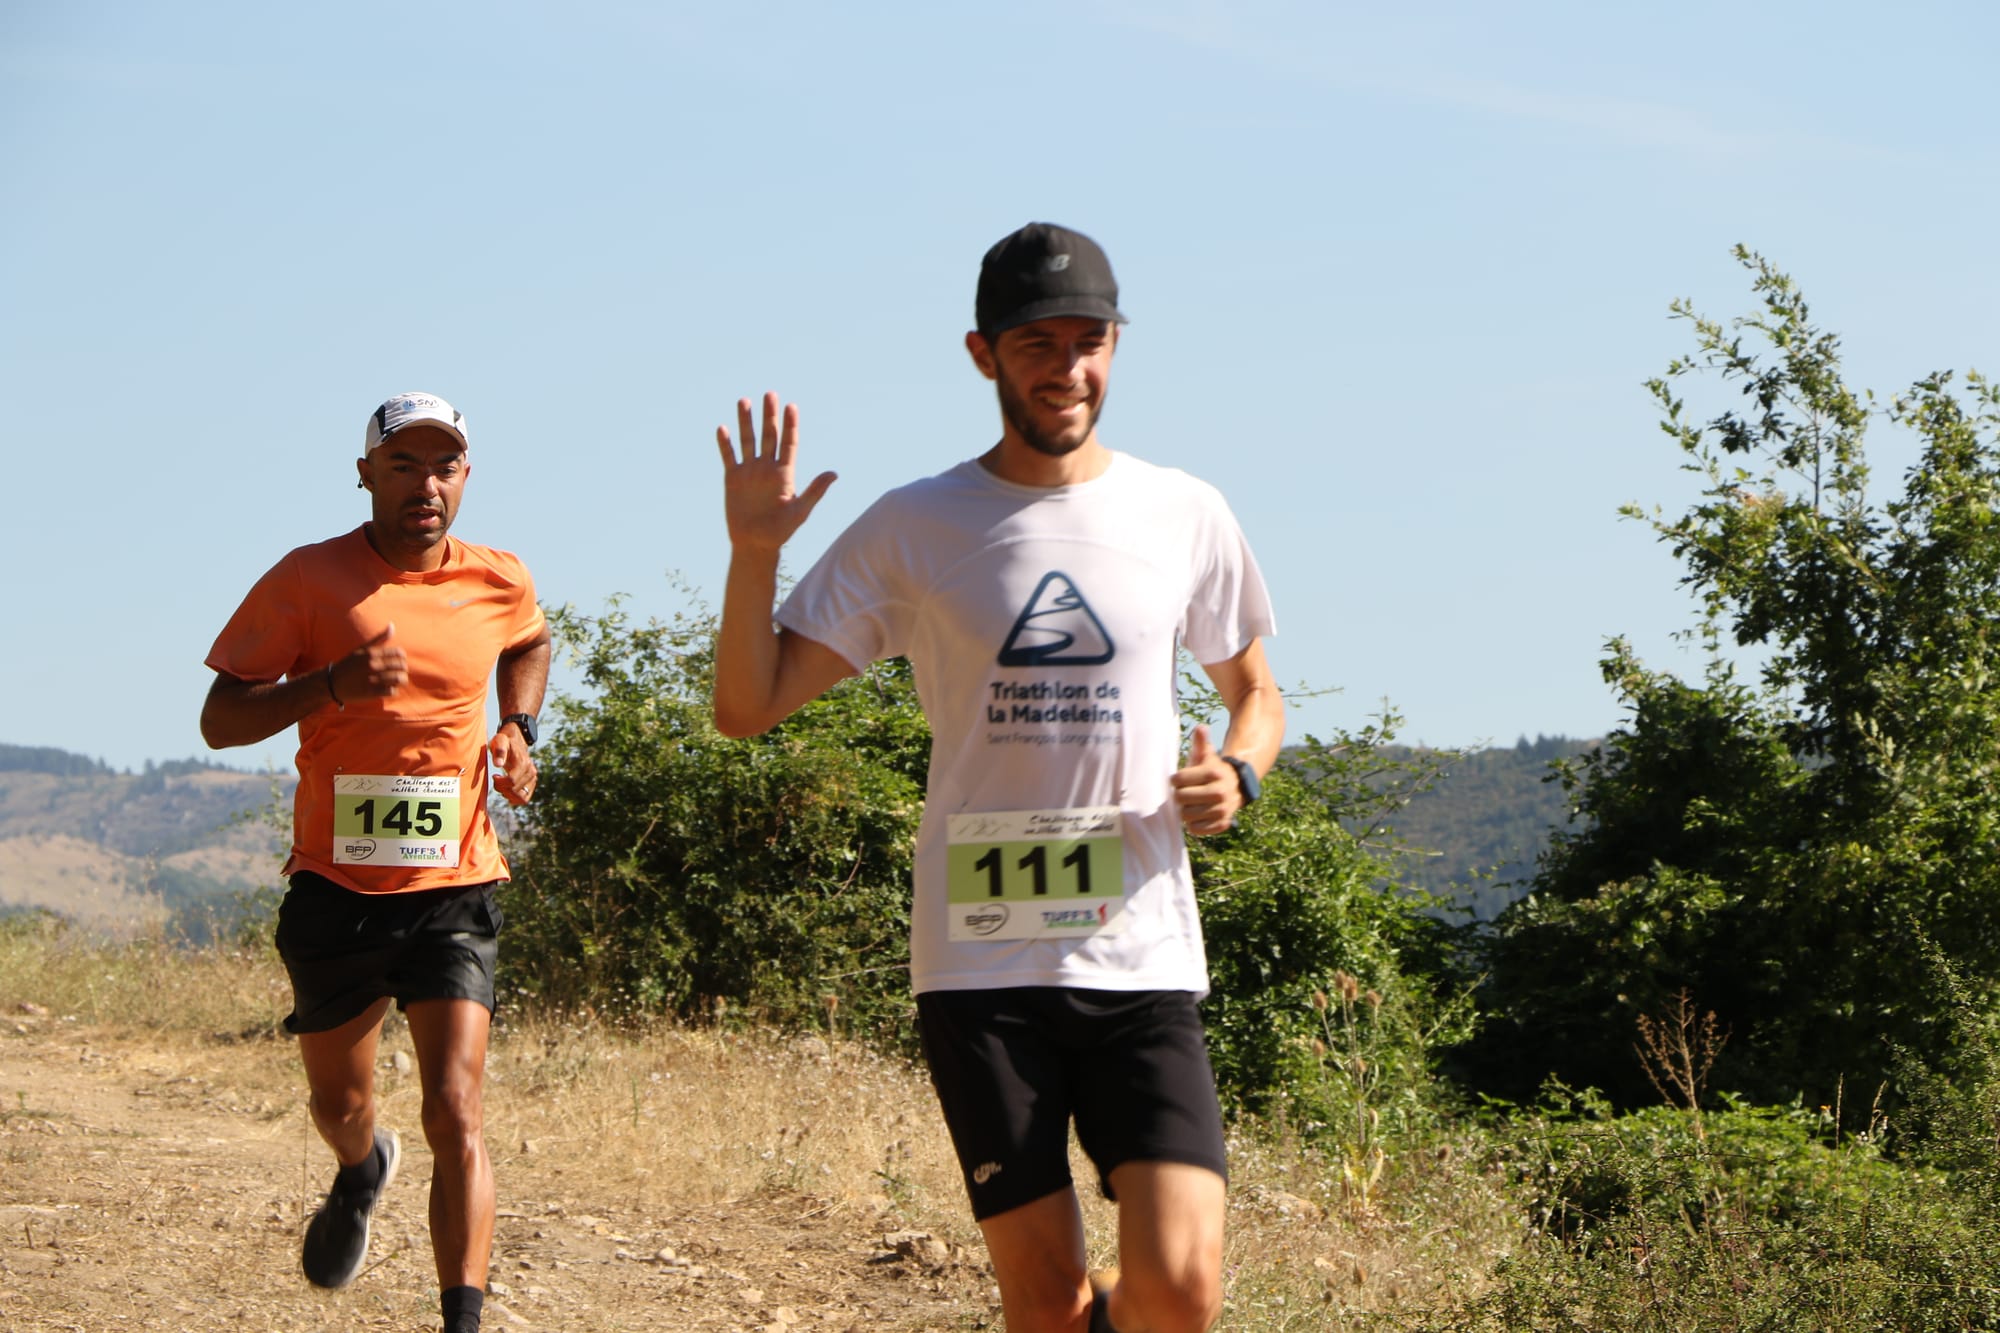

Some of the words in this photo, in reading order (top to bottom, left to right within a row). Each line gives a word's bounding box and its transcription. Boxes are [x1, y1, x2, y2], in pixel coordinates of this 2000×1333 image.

[990, 681, 1089, 700] Triathlon
[1095, 681, 1121, 700] de
[987, 705, 1006, 723] la
[1011, 704, 1123, 723] Madeleine
[354, 799, 443, 837] 145
[345, 845, 373, 854] BFP
[400, 846, 436, 855] TUFF'S
[974, 843, 1092, 898] 111
